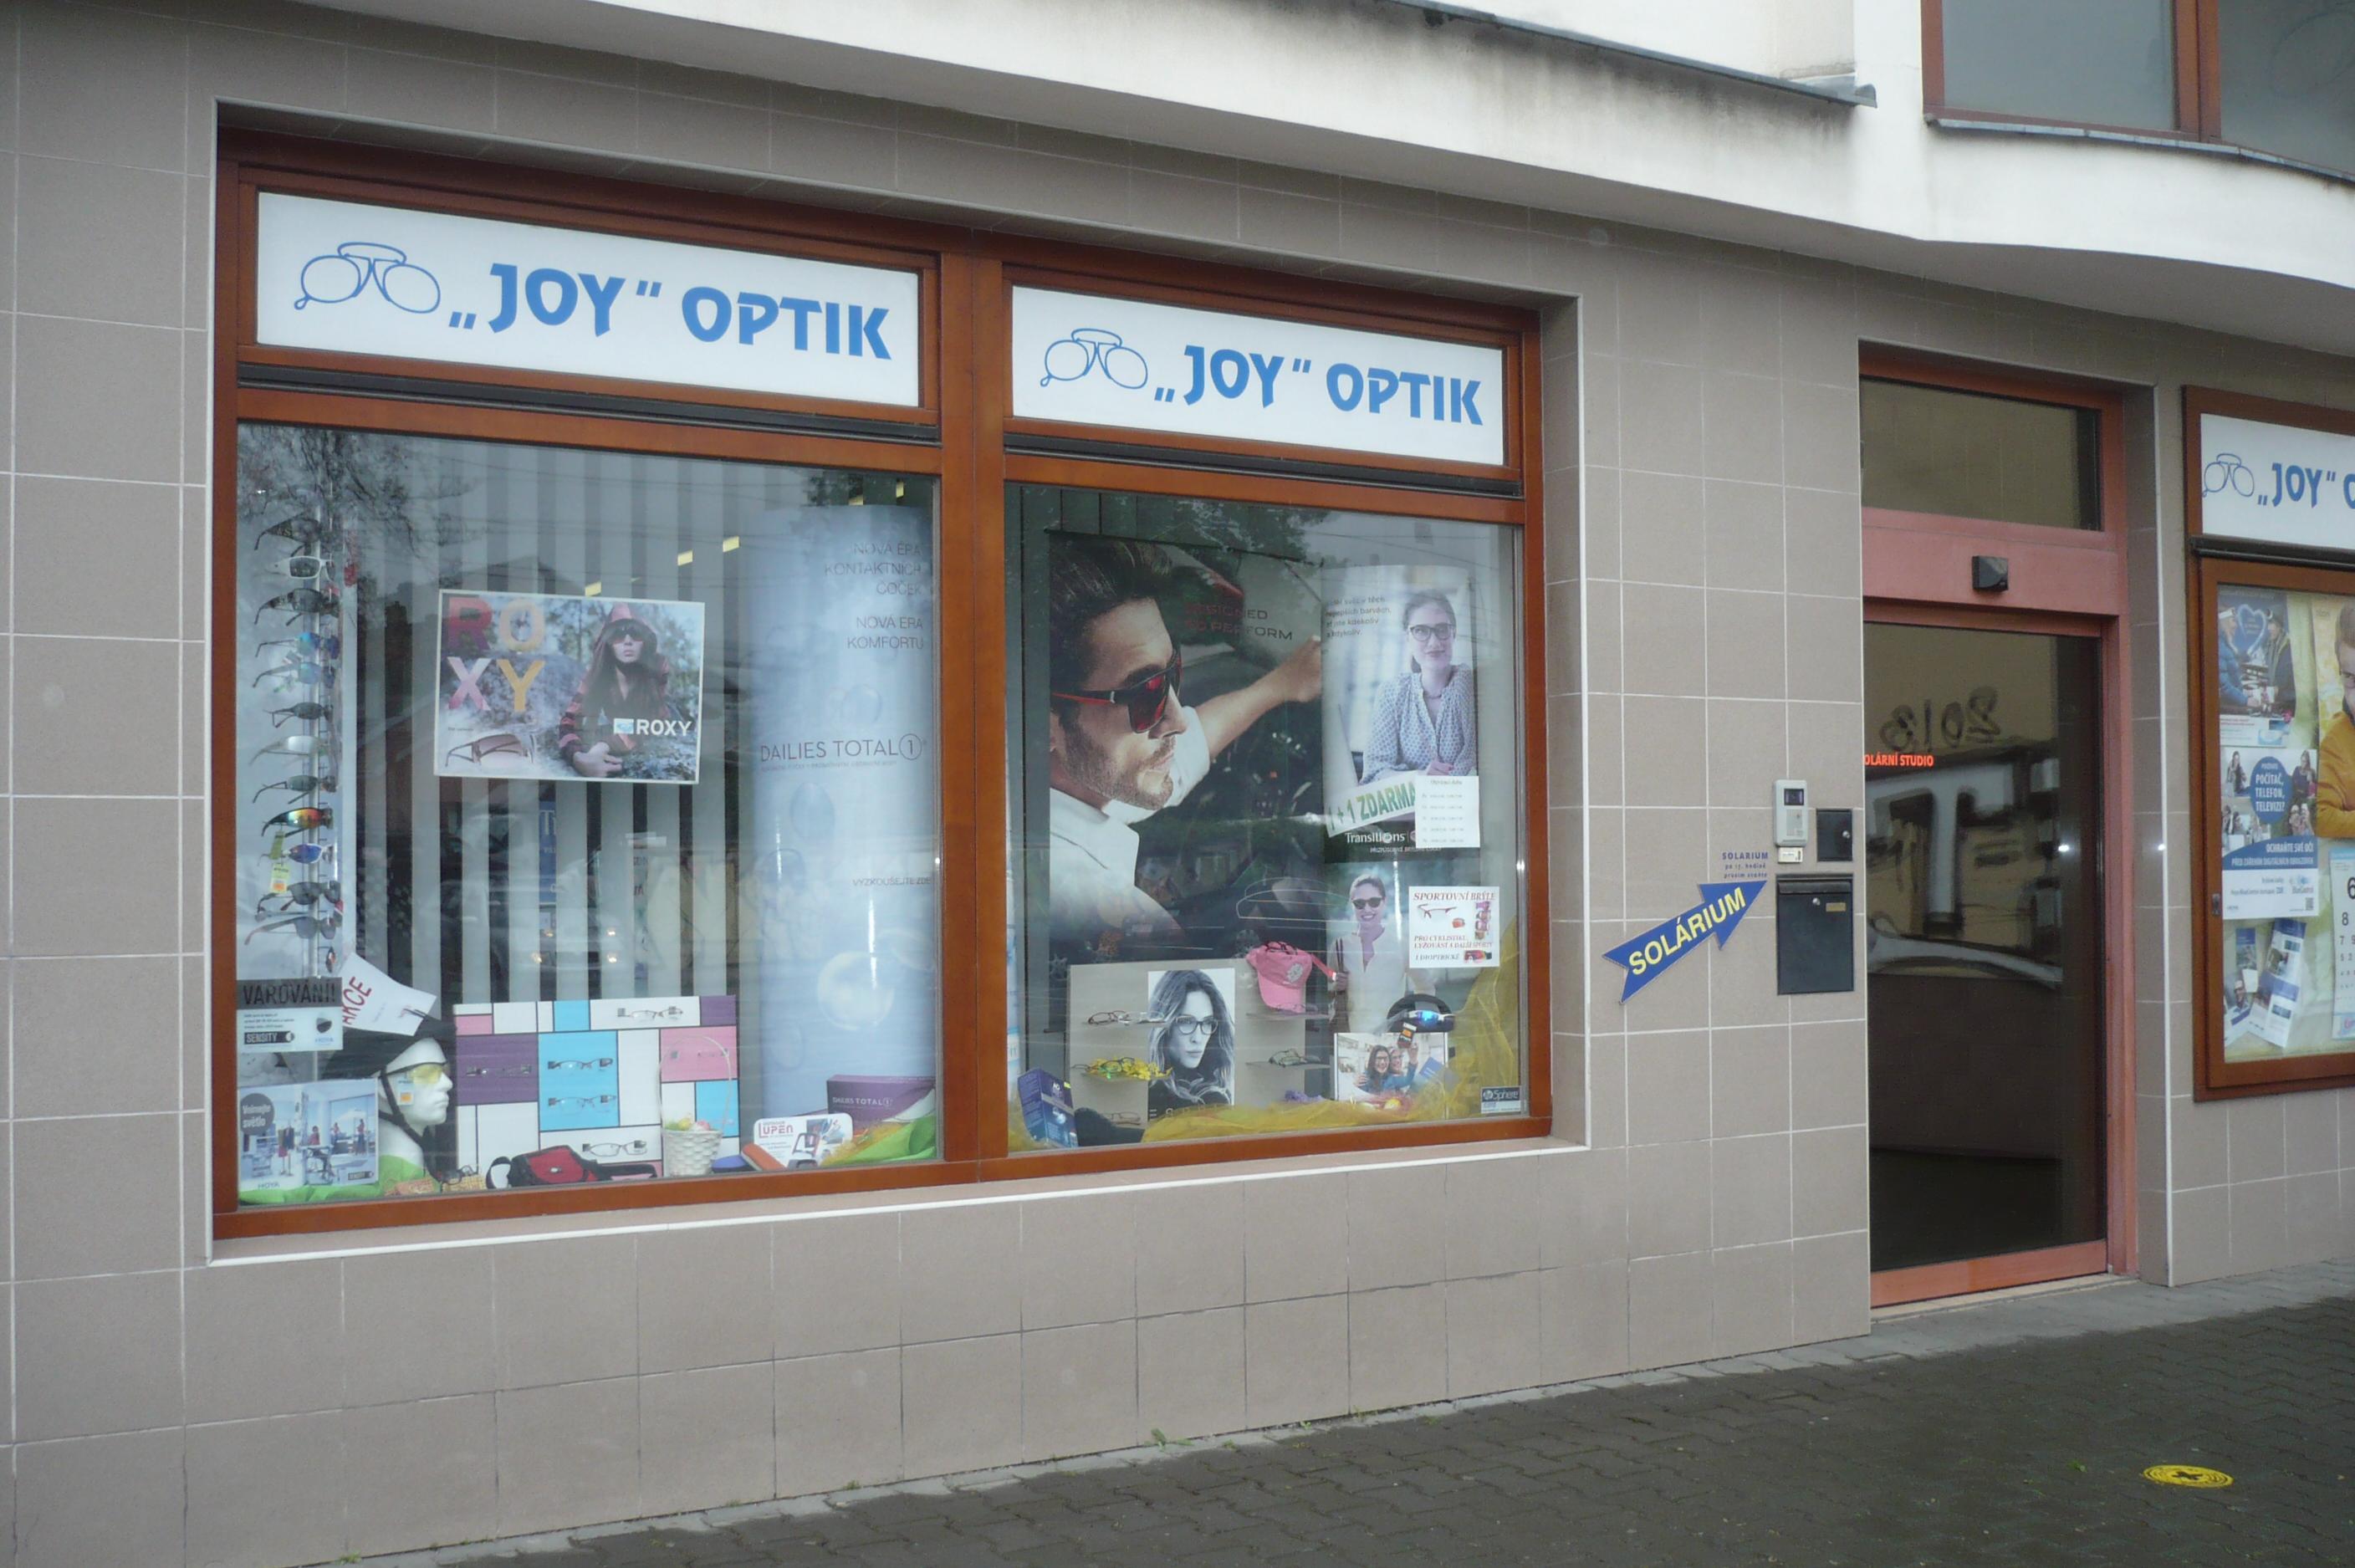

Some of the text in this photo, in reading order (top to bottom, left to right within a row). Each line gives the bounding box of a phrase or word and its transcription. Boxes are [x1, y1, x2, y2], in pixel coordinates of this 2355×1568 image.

[682, 286, 892, 360] OPTIK
[1326, 363, 1483, 426] OPTIK
[846, 636, 924, 650] KOMFORTU
[635, 719, 692, 737] ROXY
[760, 741, 826, 762] DAILIES
[1899, 754, 1934, 767] STUDIO
[1356, 781, 1416, 820] ZDARMA
[1345, 831, 1406, 844] Transitions
[1721, 851, 1769, 861] SOLARIUM
[2341, 912, 2349, 926] 8
[1628, 886, 1746, 976] SOLÁRIUM
[243, 978, 336, 1006] VAROVÁNÍ!
[246, 1032, 278, 1044] SENSITY
